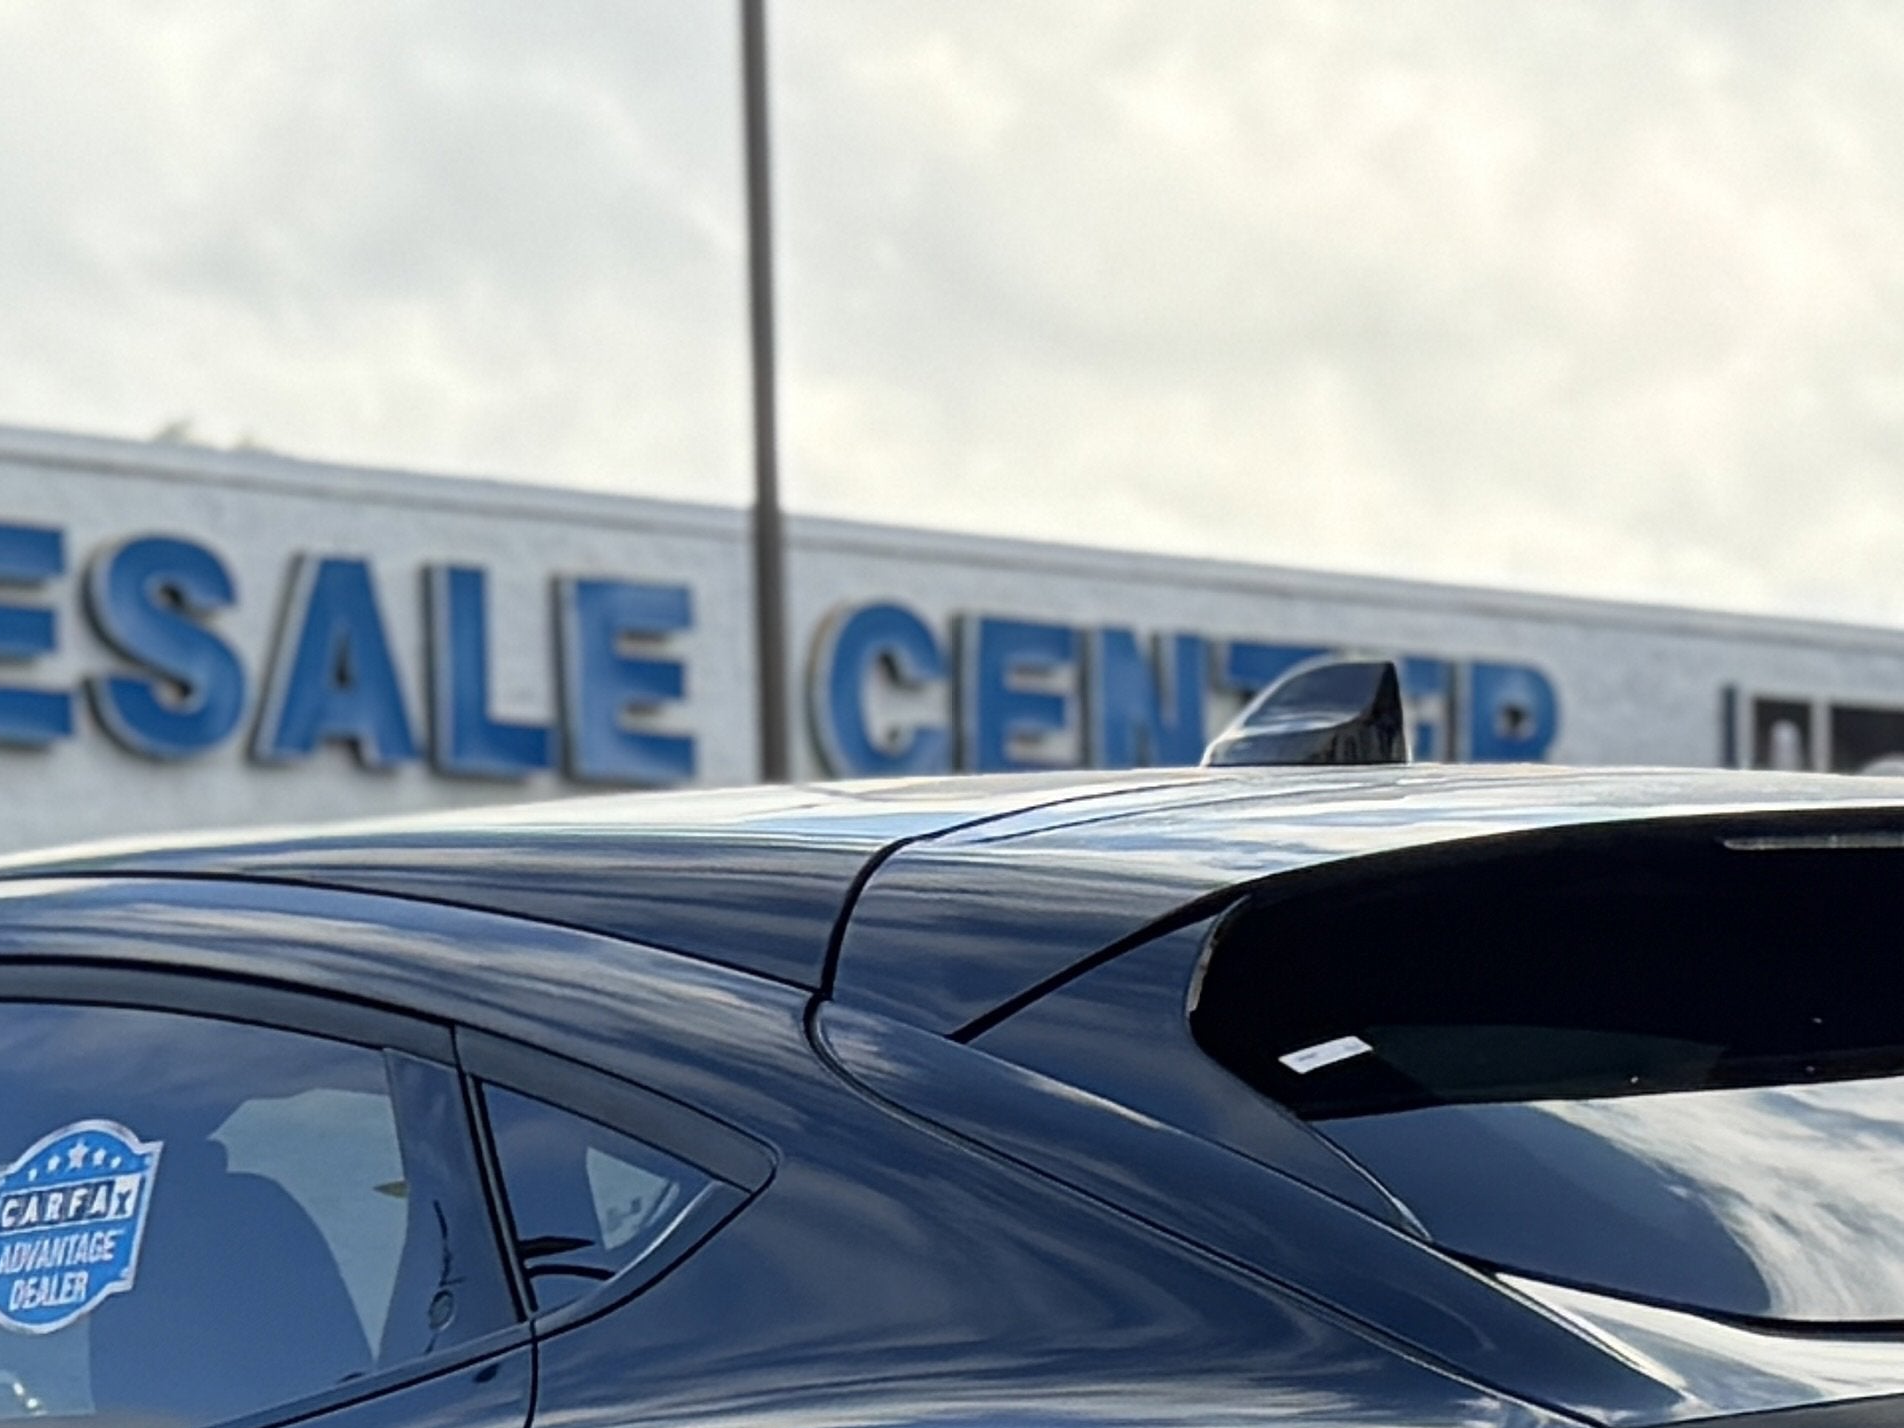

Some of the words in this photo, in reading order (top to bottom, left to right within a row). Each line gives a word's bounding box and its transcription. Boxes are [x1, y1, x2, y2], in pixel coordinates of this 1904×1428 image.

[808, 598, 1562, 775] CENR
[0, 1177, 140, 1230] CARFAX
[8, 1270, 89, 1311] DEALER
